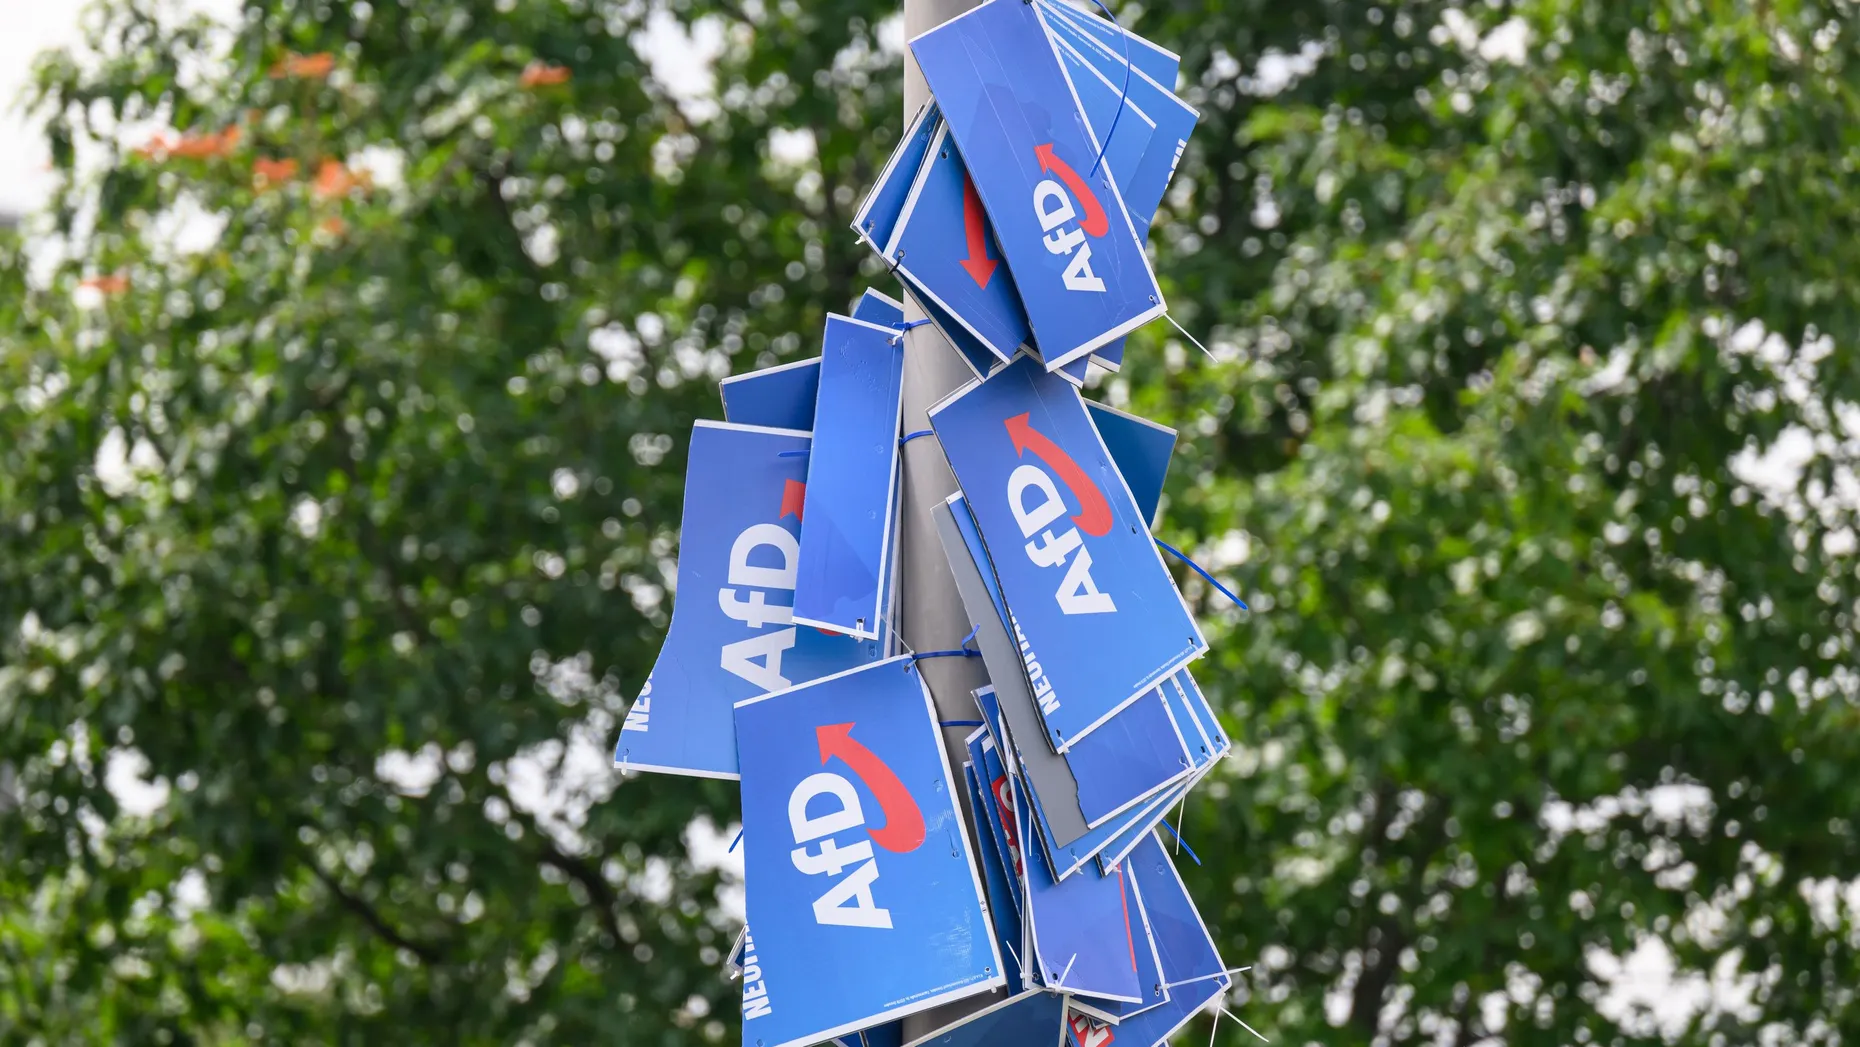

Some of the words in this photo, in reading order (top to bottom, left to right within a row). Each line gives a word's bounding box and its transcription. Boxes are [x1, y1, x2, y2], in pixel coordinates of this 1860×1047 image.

[1032, 179, 1107, 293] AfD
[718, 523, 800, 693] AfD
[1006, 464, 1118, 615] AfD
[788, 772, 894, 930] AfD
